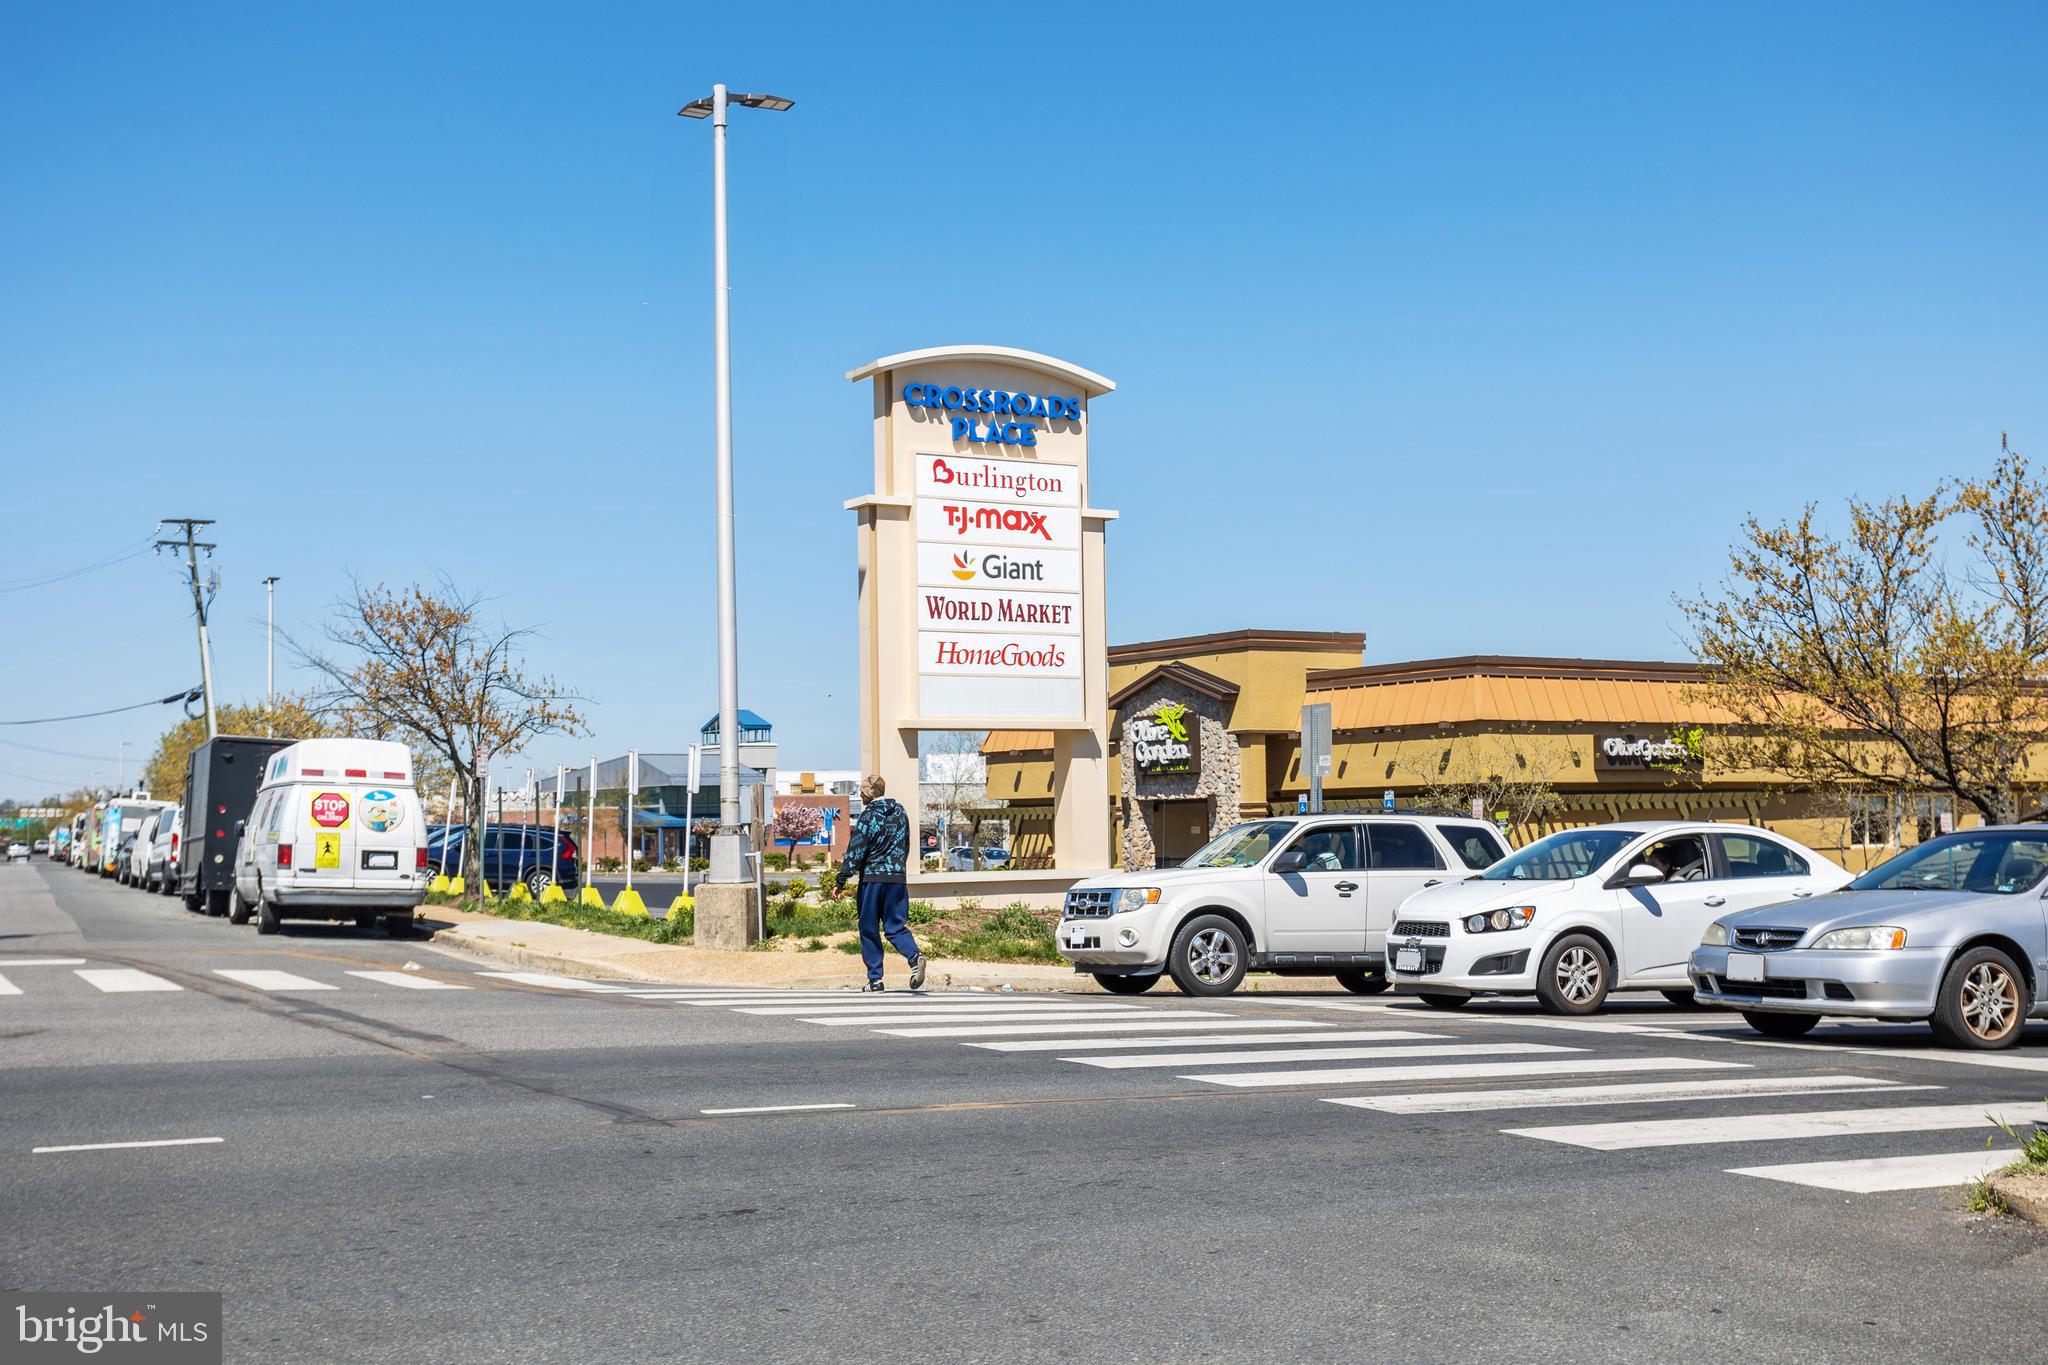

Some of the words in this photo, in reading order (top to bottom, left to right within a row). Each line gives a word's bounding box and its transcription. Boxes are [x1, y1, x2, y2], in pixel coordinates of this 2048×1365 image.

[904, 383, 1081, 420] CROSSROADS
[952, 418, 1037, 447] PLACE
[933, 459, 1062, 497] Burlington
[982, 555, 1043, 581] Giant
[925, 596, 993, 622] WORLD
[998, 599, 1072, 625] MARKET
[936, 642, 1065, 668] HomeGoods
[1131, 720, 1169, 742] Olive
[1135, 740, 1190, 767] Garden
[1604, 738, 1641, 756] Olive
[313, 800, 347, 811] STOP
